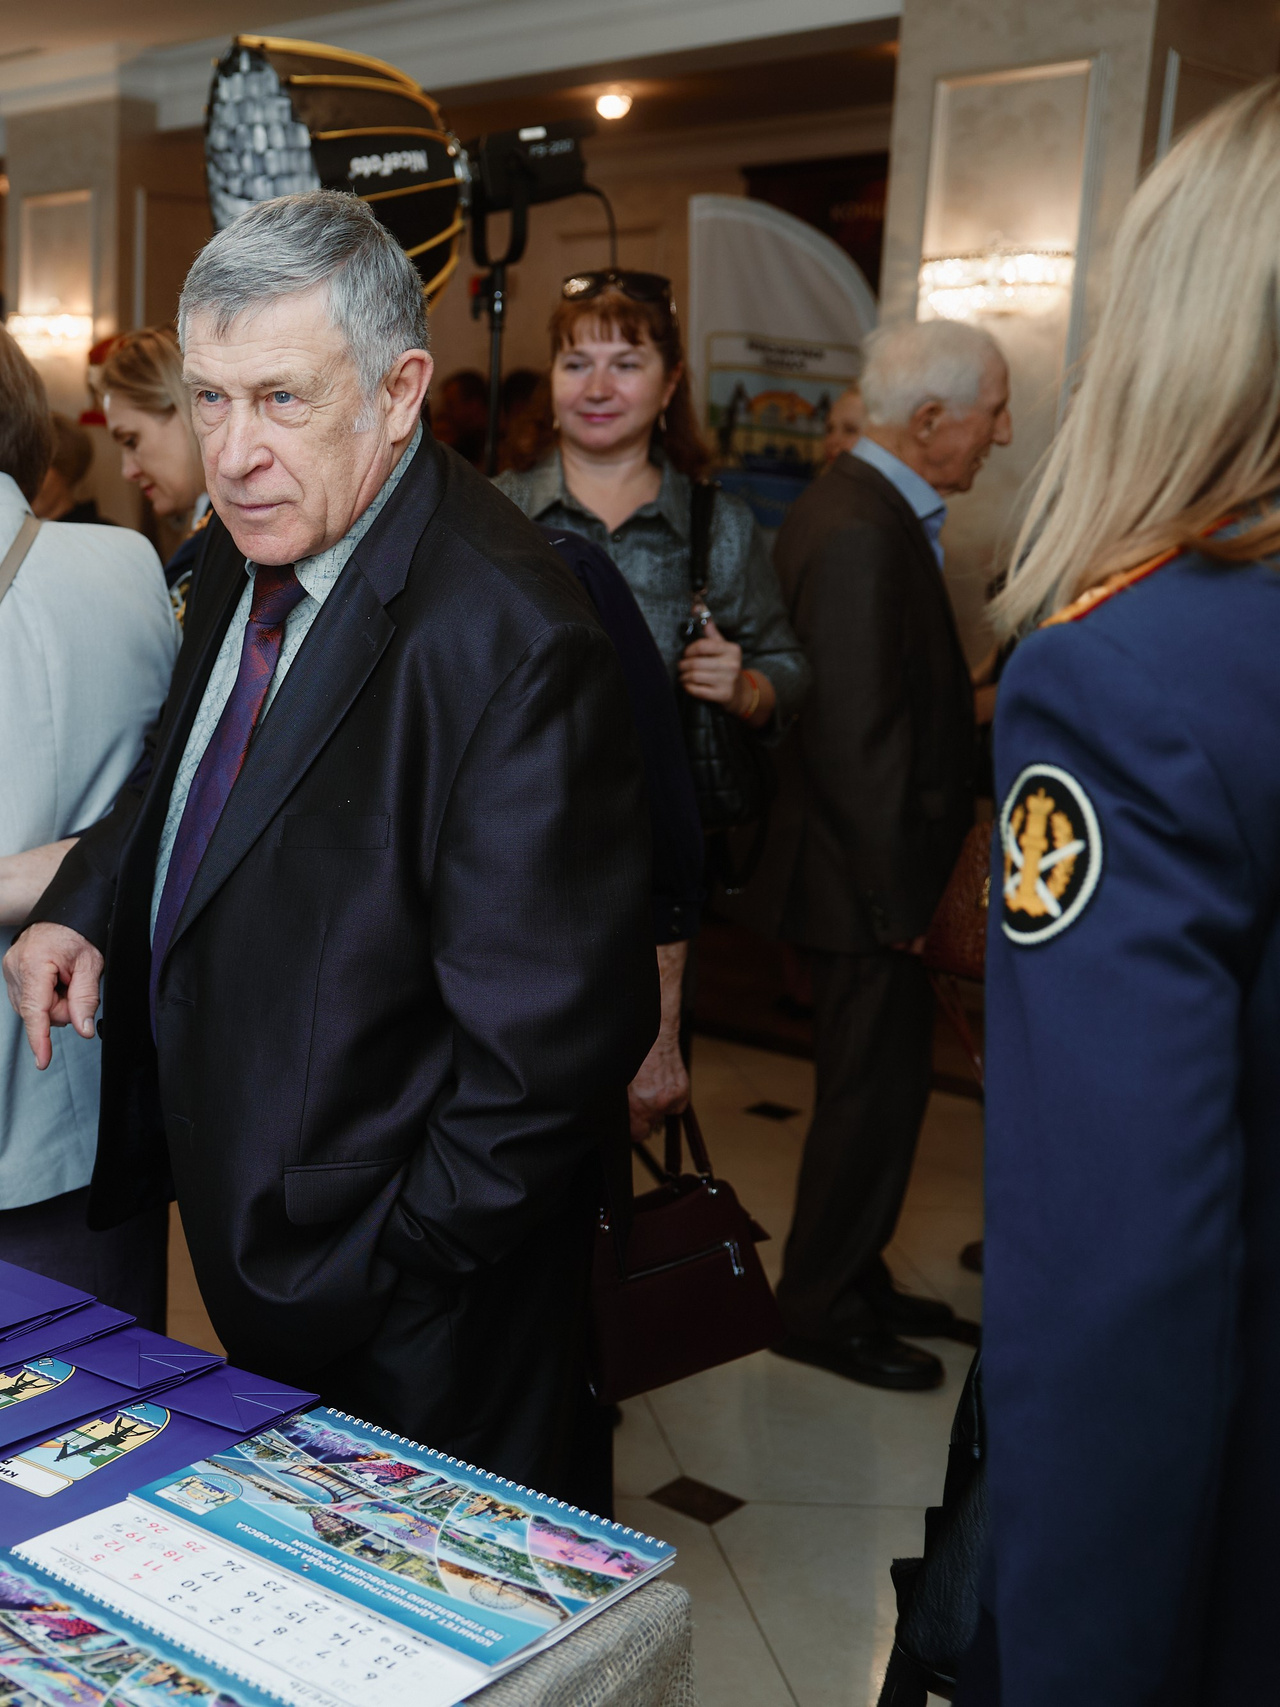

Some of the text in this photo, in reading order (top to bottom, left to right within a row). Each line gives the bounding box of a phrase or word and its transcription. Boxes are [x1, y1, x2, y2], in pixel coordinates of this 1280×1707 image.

[104, 1540, 124, 1552] 12
[90, 1554, 105, 1562] 5
[57, 1558, 92, 1575] 2026
[143, 1560, 162, 1571] 11
[147, 1523, 419, 1657] 20 21 22 23 24 25 26
[181, 1580, 202, 1592] 10
[236, 1522, 494, 1647] КОМИТЕТ АДМИНИСТРАЦИИ ГОРОДА ХАБАРОВСКА
[291, 1540, 503, 1640] ПО УПРАВЛЕНИЮ КИРОВСКИМ РАЙОНОМ
[126, 1533, 396, 1668] 13 14 15 16 17 18 19
[209, 1616, 224, 1624] 2
[316, 1651, 331, 1659] 7
